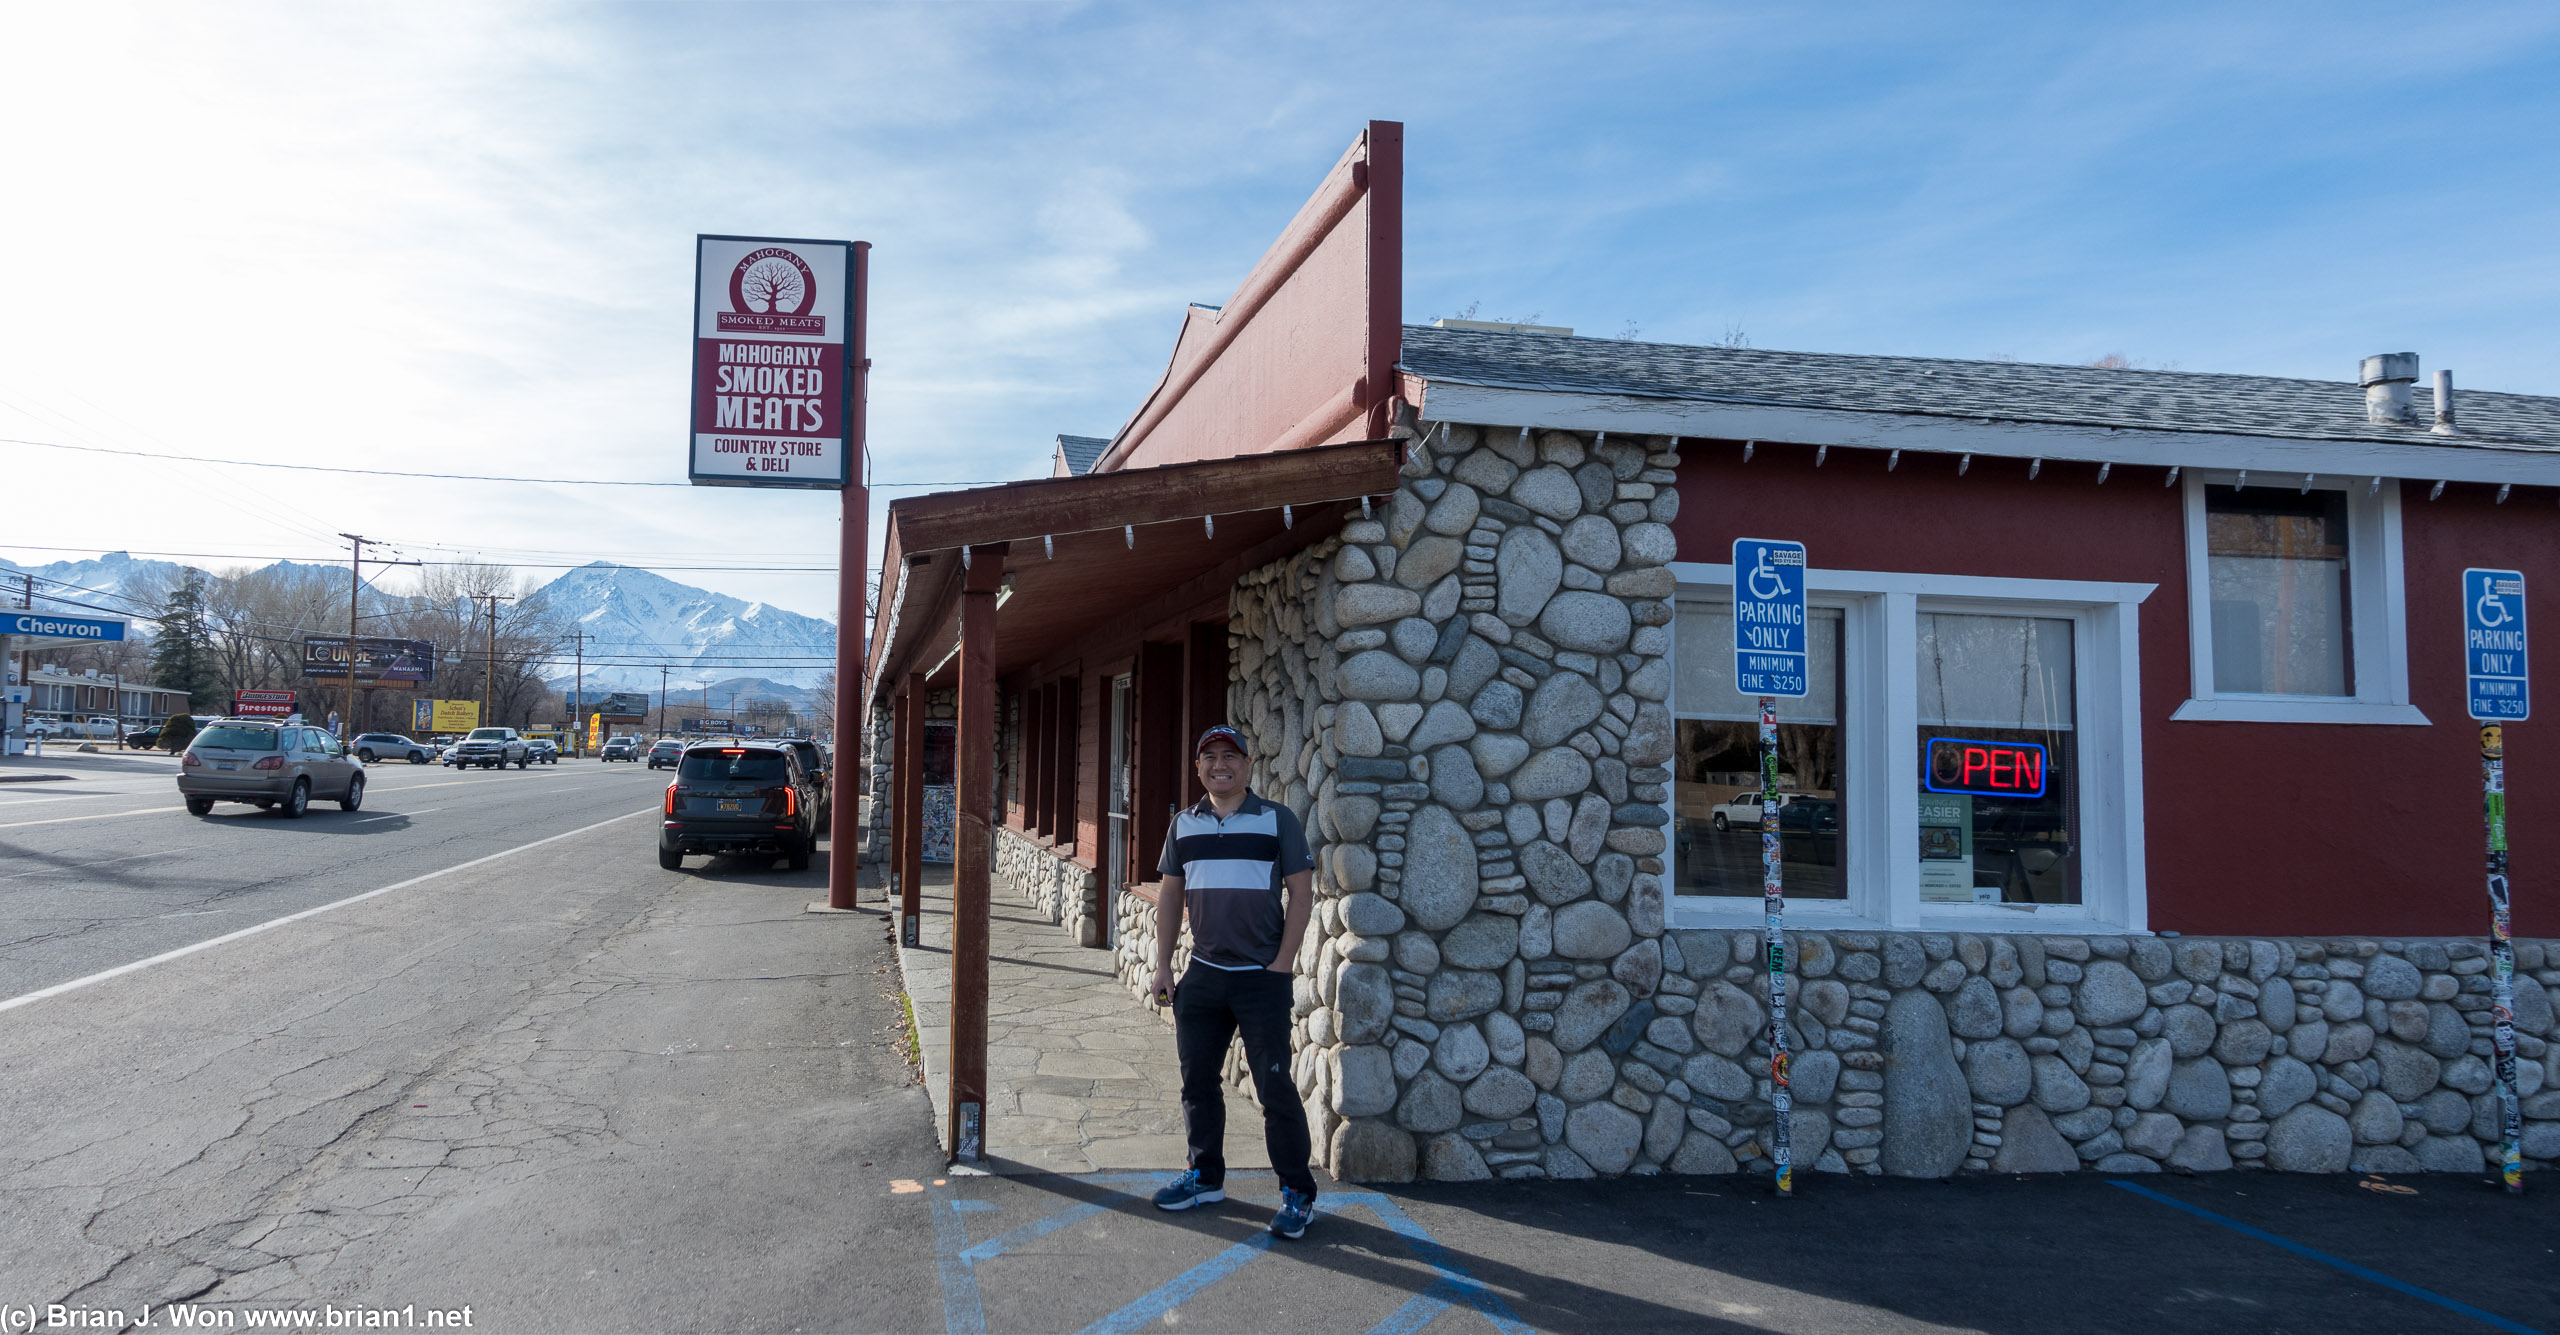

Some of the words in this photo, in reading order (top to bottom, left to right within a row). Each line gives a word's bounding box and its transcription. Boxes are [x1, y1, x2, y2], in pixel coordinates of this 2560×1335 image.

[739, 248, 810, 273] MAHOGANY
[721, 315, 774, 326] SMOKED
[780, 318, 821, 328] MEATS
[718, 343, 823, 366] MAHOGANY
[715, 364, 823, 396] SMOKED
[714, 394, 823, 433] MEATS
[714, 438, 777, 455] COUNTRY
[780, 441, 822, 457] STORE
[745, 457, 758, 472] &
[761, 457, 790, 473] DELI
[1774, 551, 1801, 560] SAVAGE
[1739, 601, 1801, 626] PARKING
[16, 616, 102, 637] Chevron
[1752, 625, 1790, 649] ONLY
[2470, 629, 2523, 651] PARKING
[1749, 655, 1794, 673] MINIMUM
[2481, 652, 2513, 674] ONLY
[1742, 673, 1765, 689] FINE
[1772, 675, 1802, 691] $250
[2479, 681, 2517, 696] MINIMUM
[240, 691, 290, 700] BRIDGESTONE
[238, 704, 291, 712] Firestone
[2473, 698, 2493, 713] FINE
[2499, 699, 2524, 714] $250
[589, 717, 599, 742] PHO
[1933, 748, 2041, 789] OPEN
[1918, 806, 1960, 818] EASIER
